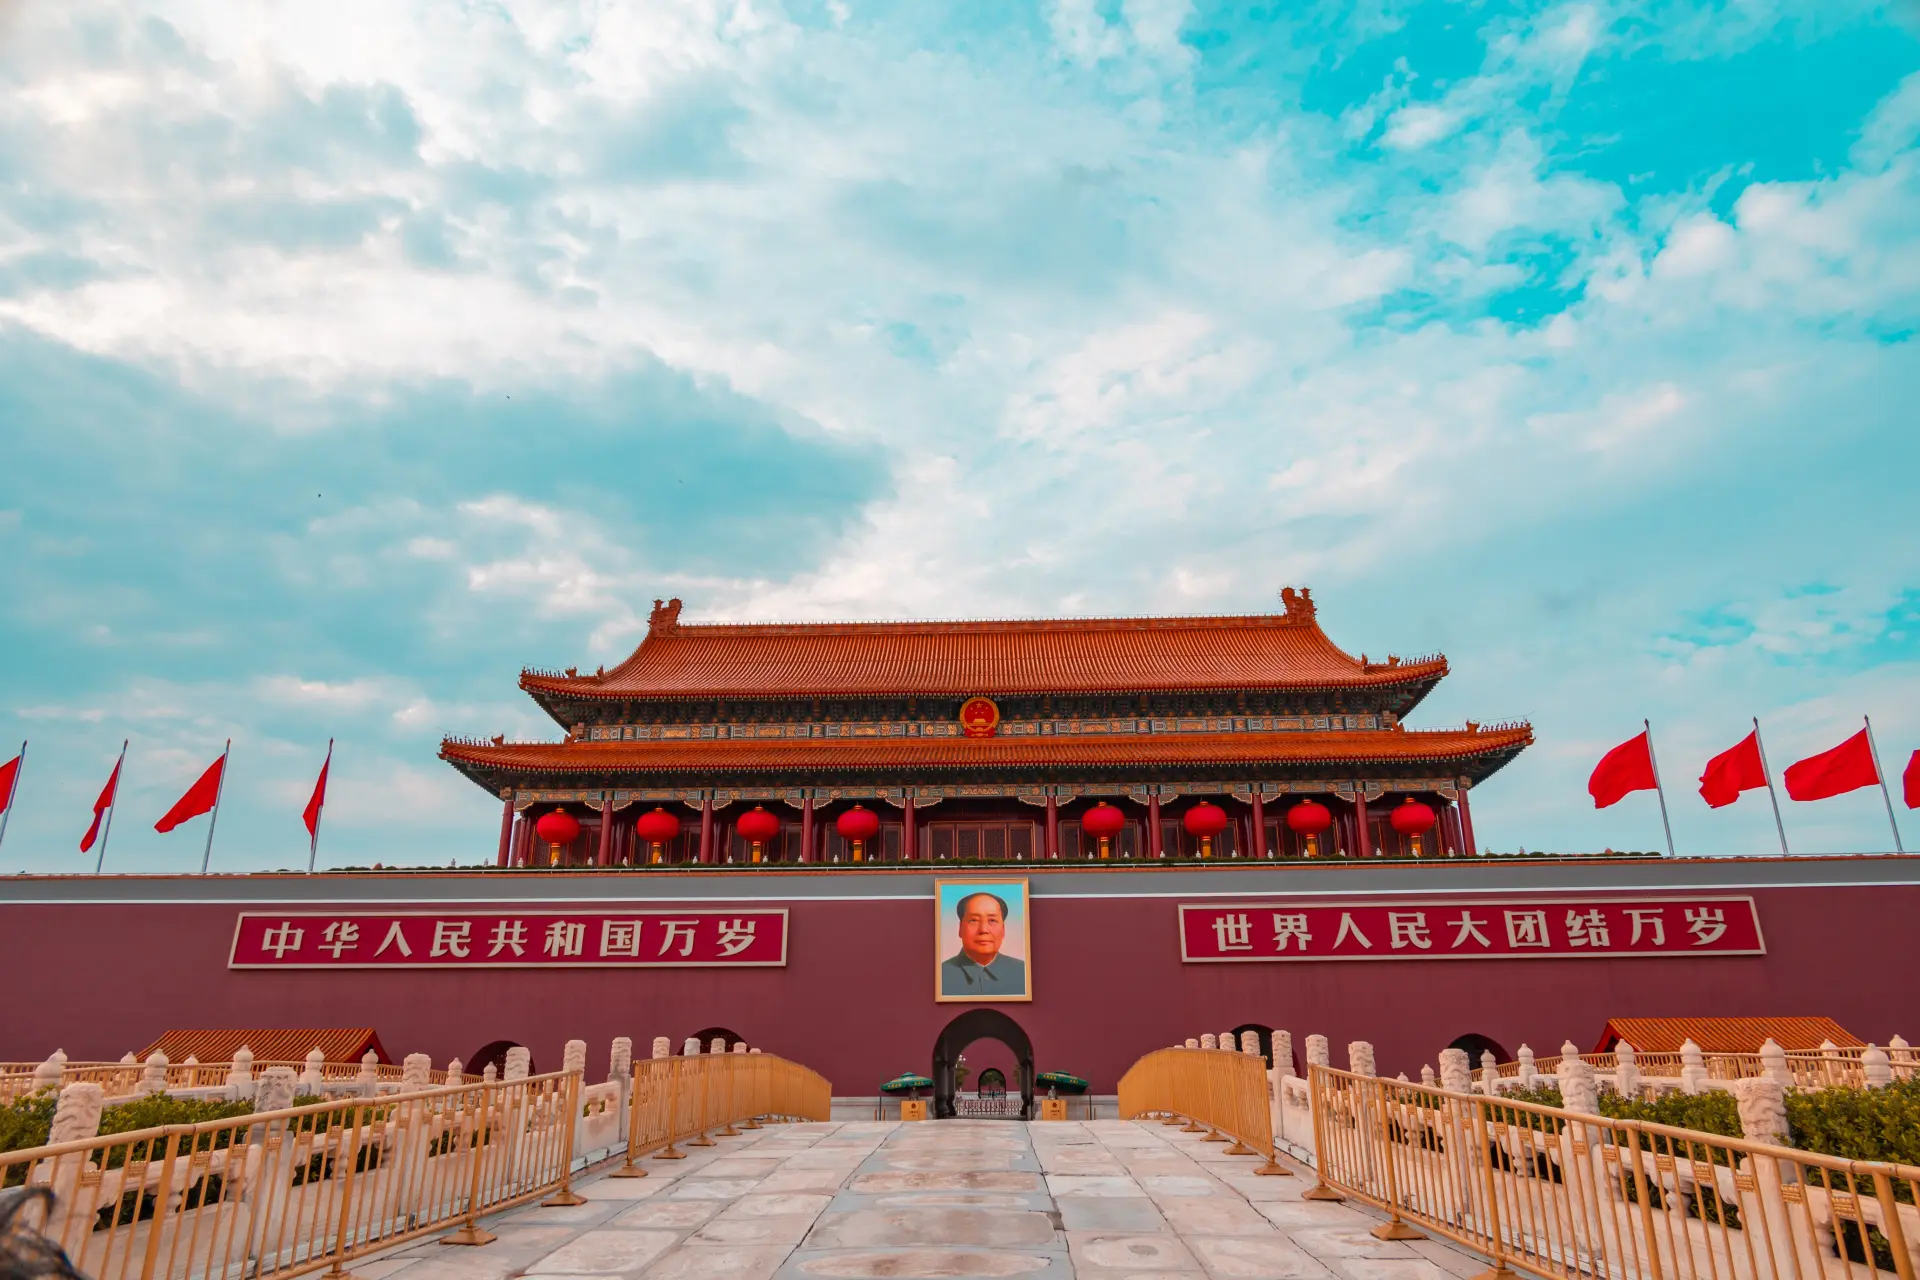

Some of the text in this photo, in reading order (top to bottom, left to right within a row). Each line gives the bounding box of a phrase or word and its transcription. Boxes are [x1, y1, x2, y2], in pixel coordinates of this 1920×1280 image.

[261, 919, 757, 959] 中华人民共和国万岁
[1211, 907, 1727, 952] 世界人民大团结万岁
